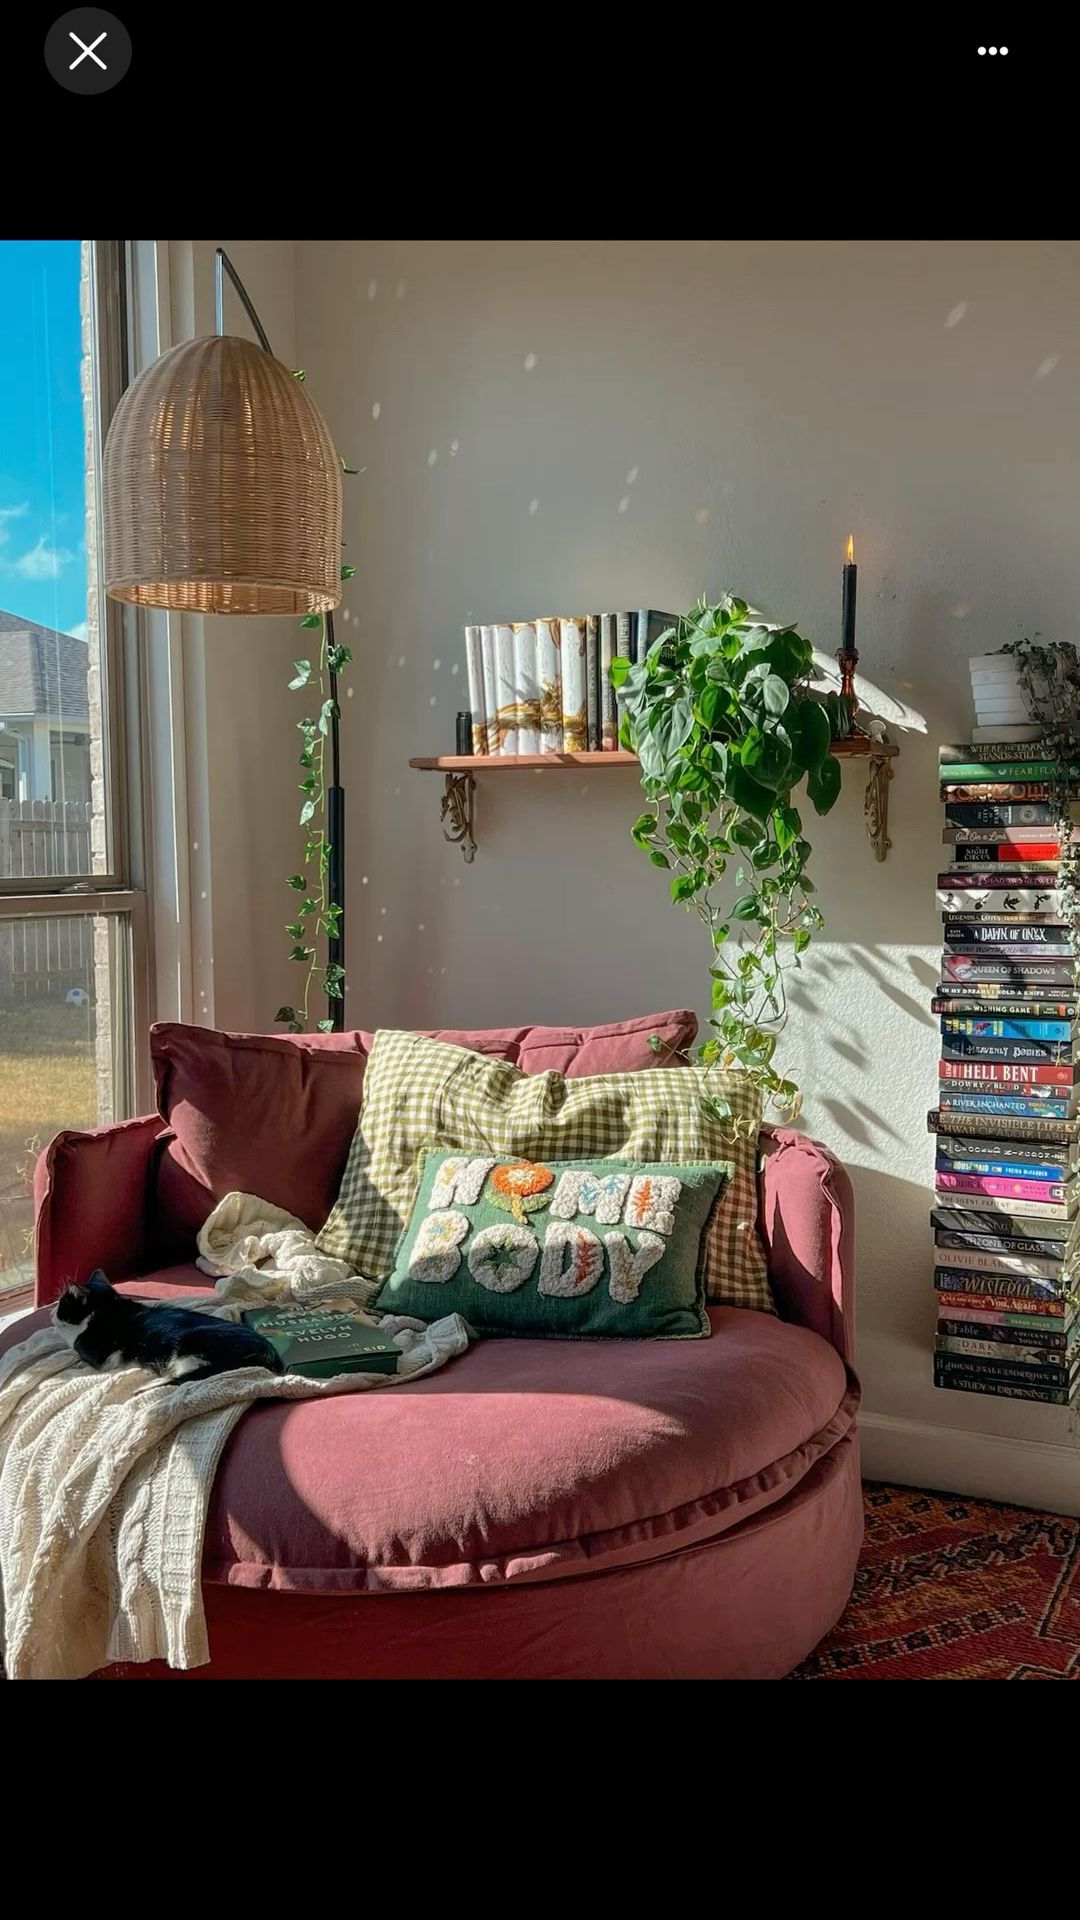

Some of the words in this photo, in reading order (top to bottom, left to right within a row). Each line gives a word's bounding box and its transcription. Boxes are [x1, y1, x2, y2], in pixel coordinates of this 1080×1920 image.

[970, 745, 1001, 753] WHERE
[1017, 743, 1043, 752] DARK
[1013, 751, 1038, 760] STILL
[1009, 767, 1032, 775] FEAR
[955, 832, 968, 841] Out
[970, 832, 981, 841] On
[989, 831, 1007, 841] Limb
[984, 877, 1023, 885] SHADOWS
[980, 928, 1009, 941] DAWN
[1010, 928, 1021, 940] OF
[1022, 928, 1047, 941] ONYX
[971, 966, 1000, 974] QUEEN
[1001, 966, 1011, 974] OF
[1013, 966, 1056, 975] SHADOWS
[973, 1005, 1007, 1013] WISHING
[1010, 1006, 1031, 1014] GAME
[966, 1044, 1009, 1057] HEAVENLY
[1013, 1046, 1048, 1058] BODIES
[963, 1064, 998, 1080] HELL
[1003, 1066, 1039, 1082] BENT
[951, 1081, 983, 1089] DOWRY
[952, 1099, 977, 1107] RIVER
[977, 1100, 1026, 1110] ENCHANTED
[950, 1115, 973, 1125] THE
[975, 1117, 1033, 1131] INVISIBLE
[1034, 1120, 1065, 1132] LIFE
[929, 1124, 976, 1135] SCHWAB
[980, 1126, 995, 1136] OF
[996, 1128, 1030, 1139] ADDIE
[953, 1144, 1000, 1155] CROOKED
[1004, 1149, 1051, 1159] KINGDOM
[955, 1197, 979, 1206] SILENT
[981, 1199, 1010, 1208] PATIENT
[965, 1236, 1002, 1248] THRONE
[1003, 1240, 1016, 1249] OF
[1017, 1242, 1046, 1253] GLASS
[408, 1210, 666, 1304] BODY
[939, 1254, 974, 1265] OLIVIE
[960, 1275, 1031, 1298] WISTERIA
[1011, 1301, 1038, 1311] Again
[276, 1309, 331, 1320] SEVEN
[286, 1324, 352, 1337] EVELYN
[947, 1322, 979, 1335] Fable
[297, 1331, 352, 1343] HUGO
[961, 1341, 995, 1352] DARK
